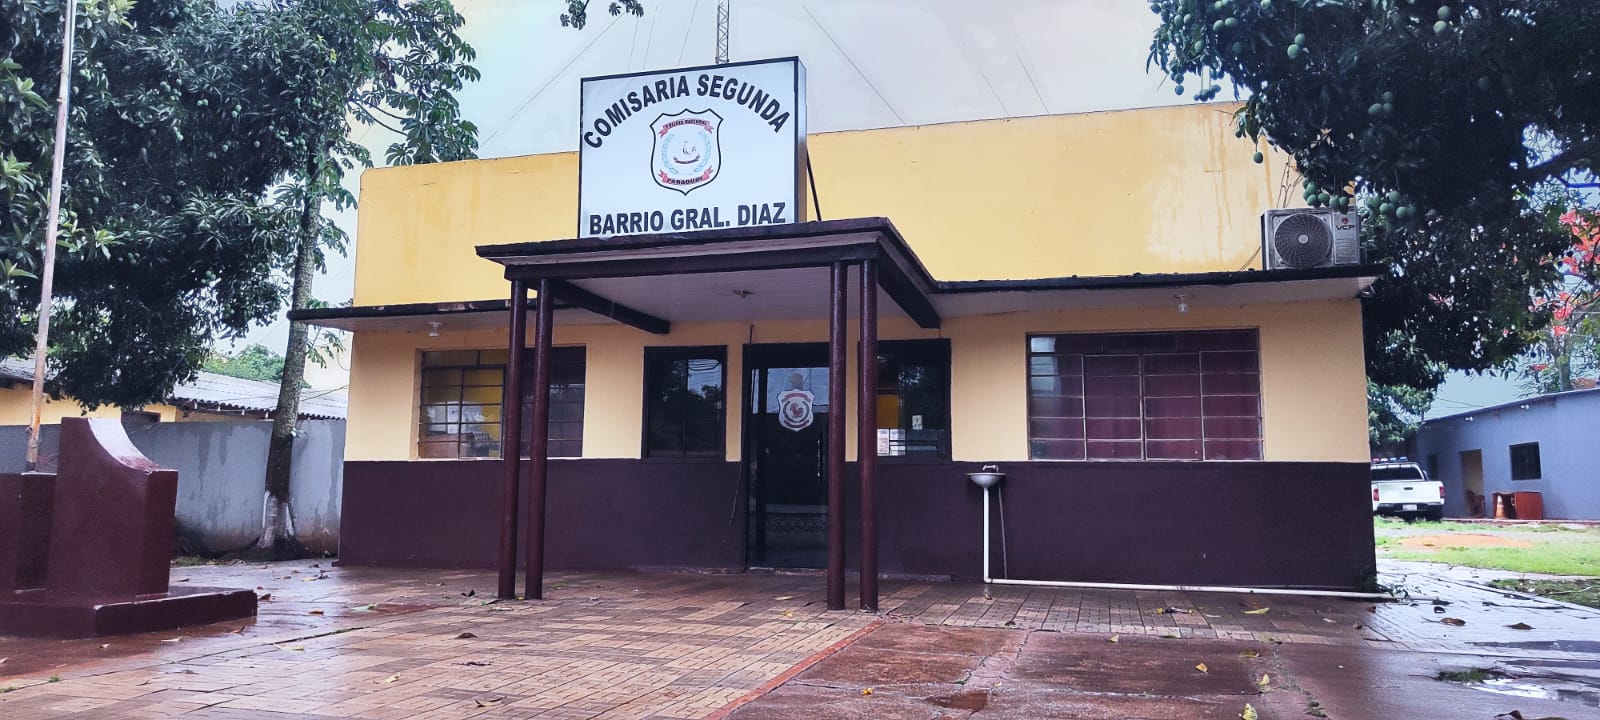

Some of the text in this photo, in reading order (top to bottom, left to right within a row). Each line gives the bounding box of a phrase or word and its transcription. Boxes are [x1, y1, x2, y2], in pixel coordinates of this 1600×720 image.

[584, 74, 791, 148] COMISARIA SEGUNDA
[589, 202, 786, 235] BARRIO GRAL. DIAZ
